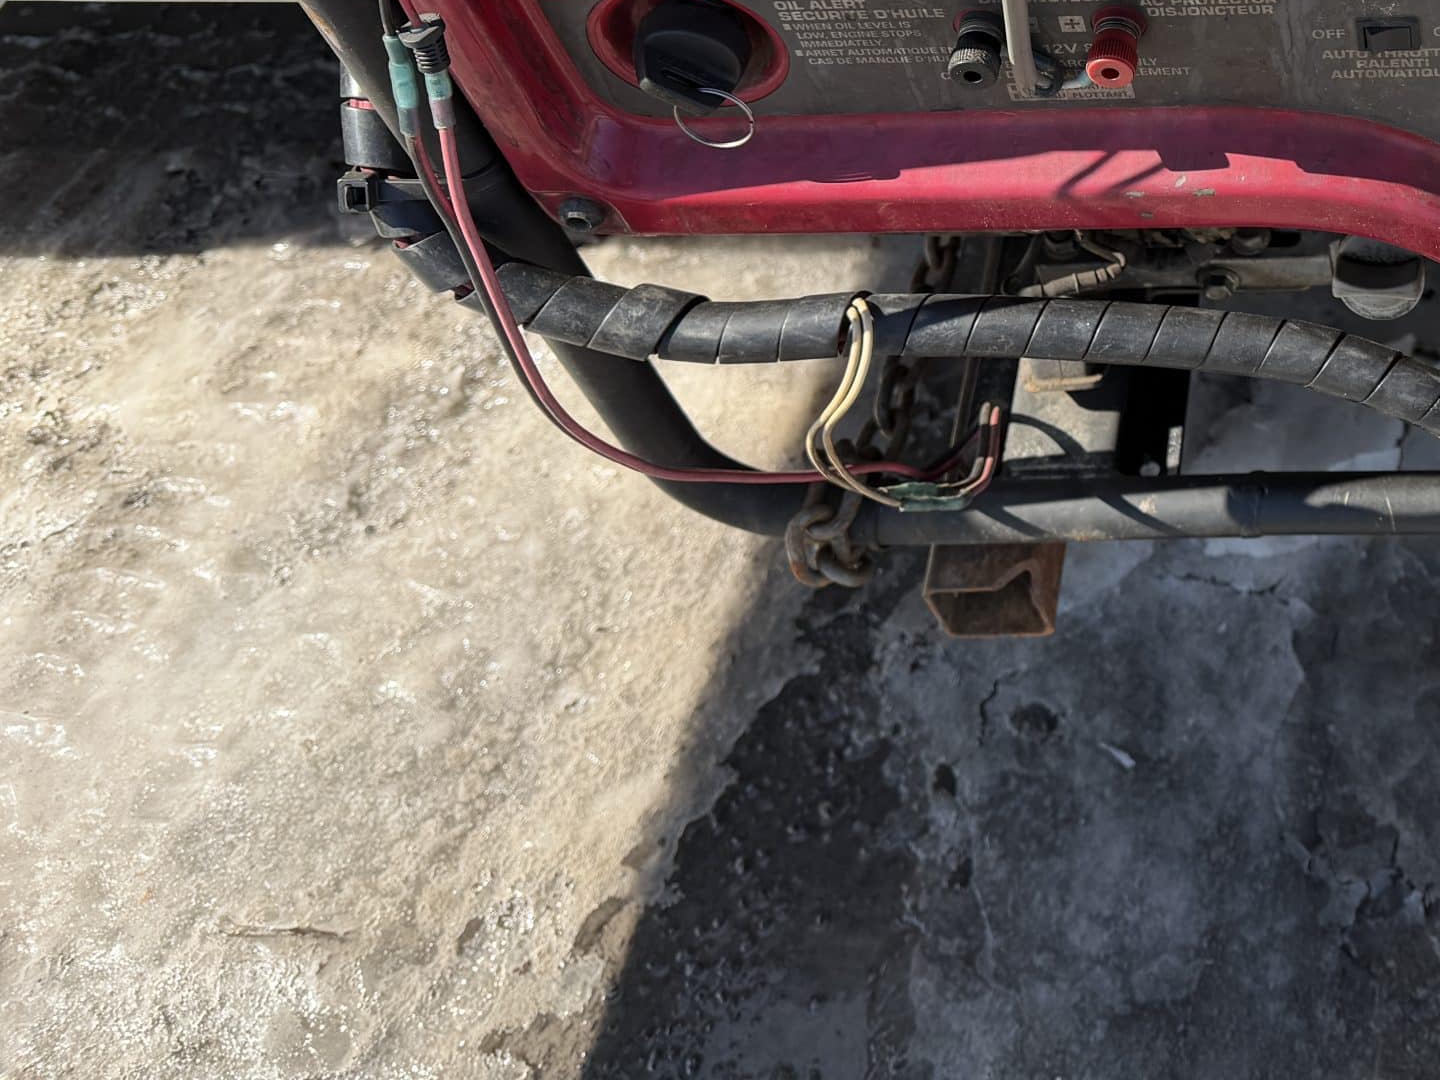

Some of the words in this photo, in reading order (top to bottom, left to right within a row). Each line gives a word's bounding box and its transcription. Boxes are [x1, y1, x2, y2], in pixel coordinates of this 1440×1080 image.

[773, 0, 805, 11] OIL
[809, 0, 866, 11] ALERT
[1146, 4, 1275, 18] DISJONCTEUR
[873, 7, 946, 20] D'HUILE
[791, 22, 833, 32] WHEN
[835, 21, 856, 31] OIL
[856, 21, 896, 31] LEVEL
[899, 20, 912, 30] IS
[834, 30, 880, 40] ENGINE
[881, 29, 923, 39] STOPS
[1311, 28, 1347, 40] OFF
[805, 48, 844, 58] ARRET
[847, 46, 938, 58] AUTOMATIQUE
[1321, 49, 1370, 61] AUTO
[808, 56, 834, 66] CAS
[837, 56, 853, 66] DE
[854, 54, 914, 65] MANQUE
[1356, 58, 1431, 70] RALENTI
